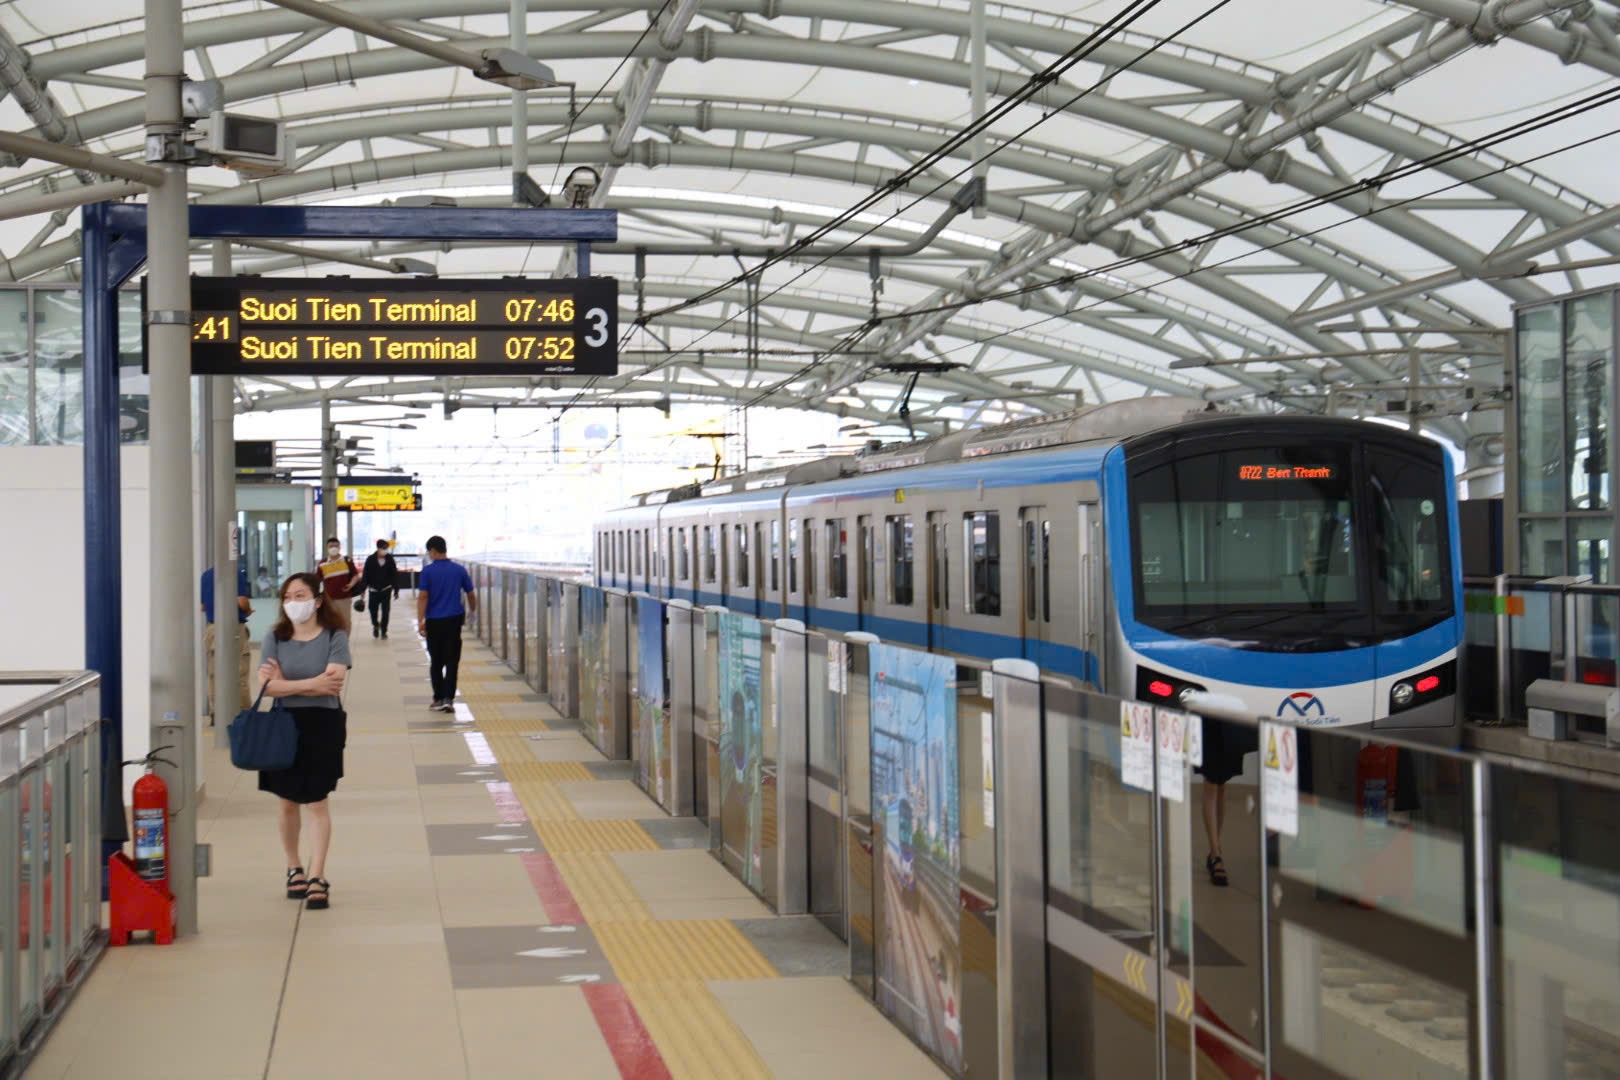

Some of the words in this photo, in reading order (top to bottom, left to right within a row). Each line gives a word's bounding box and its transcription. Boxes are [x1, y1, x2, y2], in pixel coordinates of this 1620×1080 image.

[240, 297, 297, 321] Suoi
[305, 298, 361, 321] Tien
[368, 298, 476, 322] Terminal
[505, 299, 575, 322] 07:46
[584, 307, 609, 348] 3
[240, 336, 298, 360] Suoi
[305, 336, 361, 360] Tien
[368, 337, 476, 360] Terminal
[505, 337, 575, 360] 07:52
[1266, 467, 1291, 478] Ben
